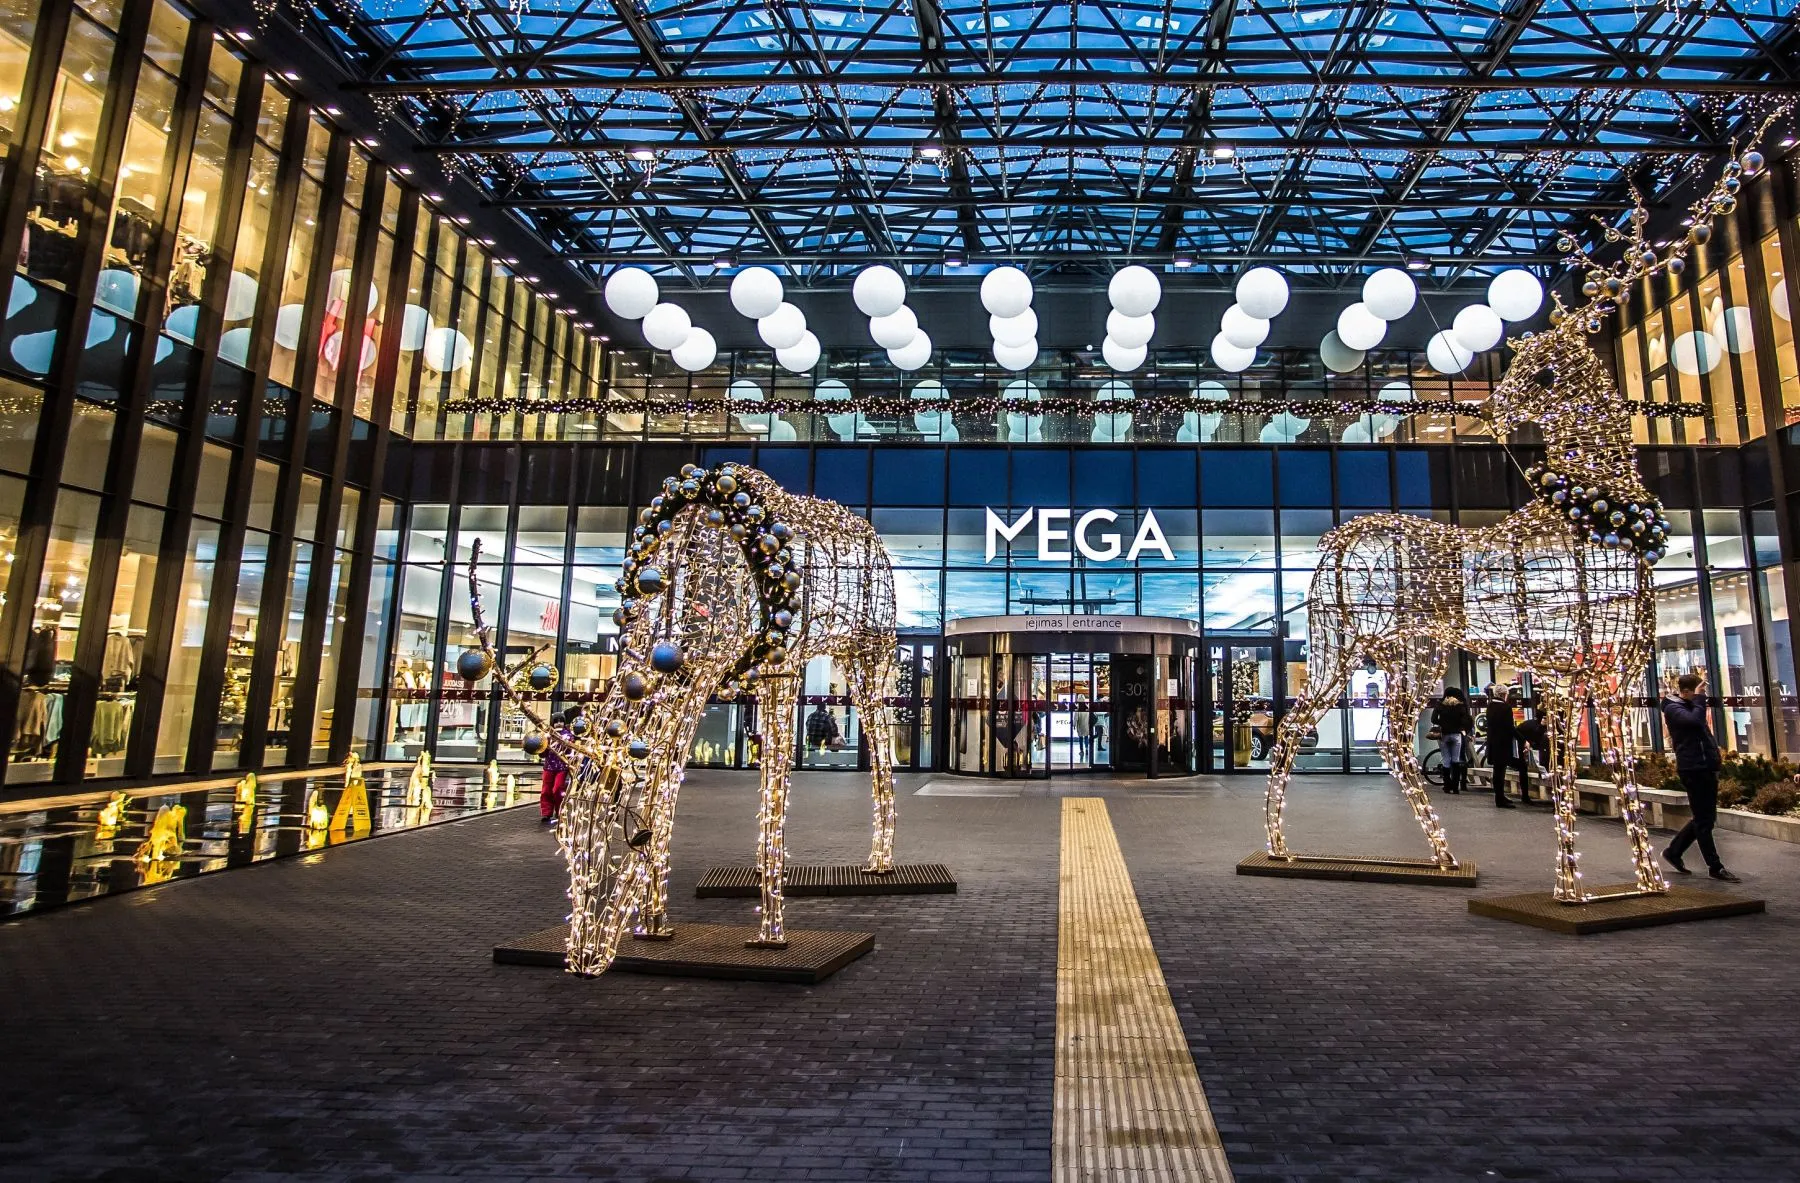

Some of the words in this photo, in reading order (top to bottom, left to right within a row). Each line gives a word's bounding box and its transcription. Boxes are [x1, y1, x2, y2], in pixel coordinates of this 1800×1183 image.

[985, 506, 1176, 565] MEGA
[1072, 617, 1122, 628] entrance
[1121, 682, 1146, 696] -30
